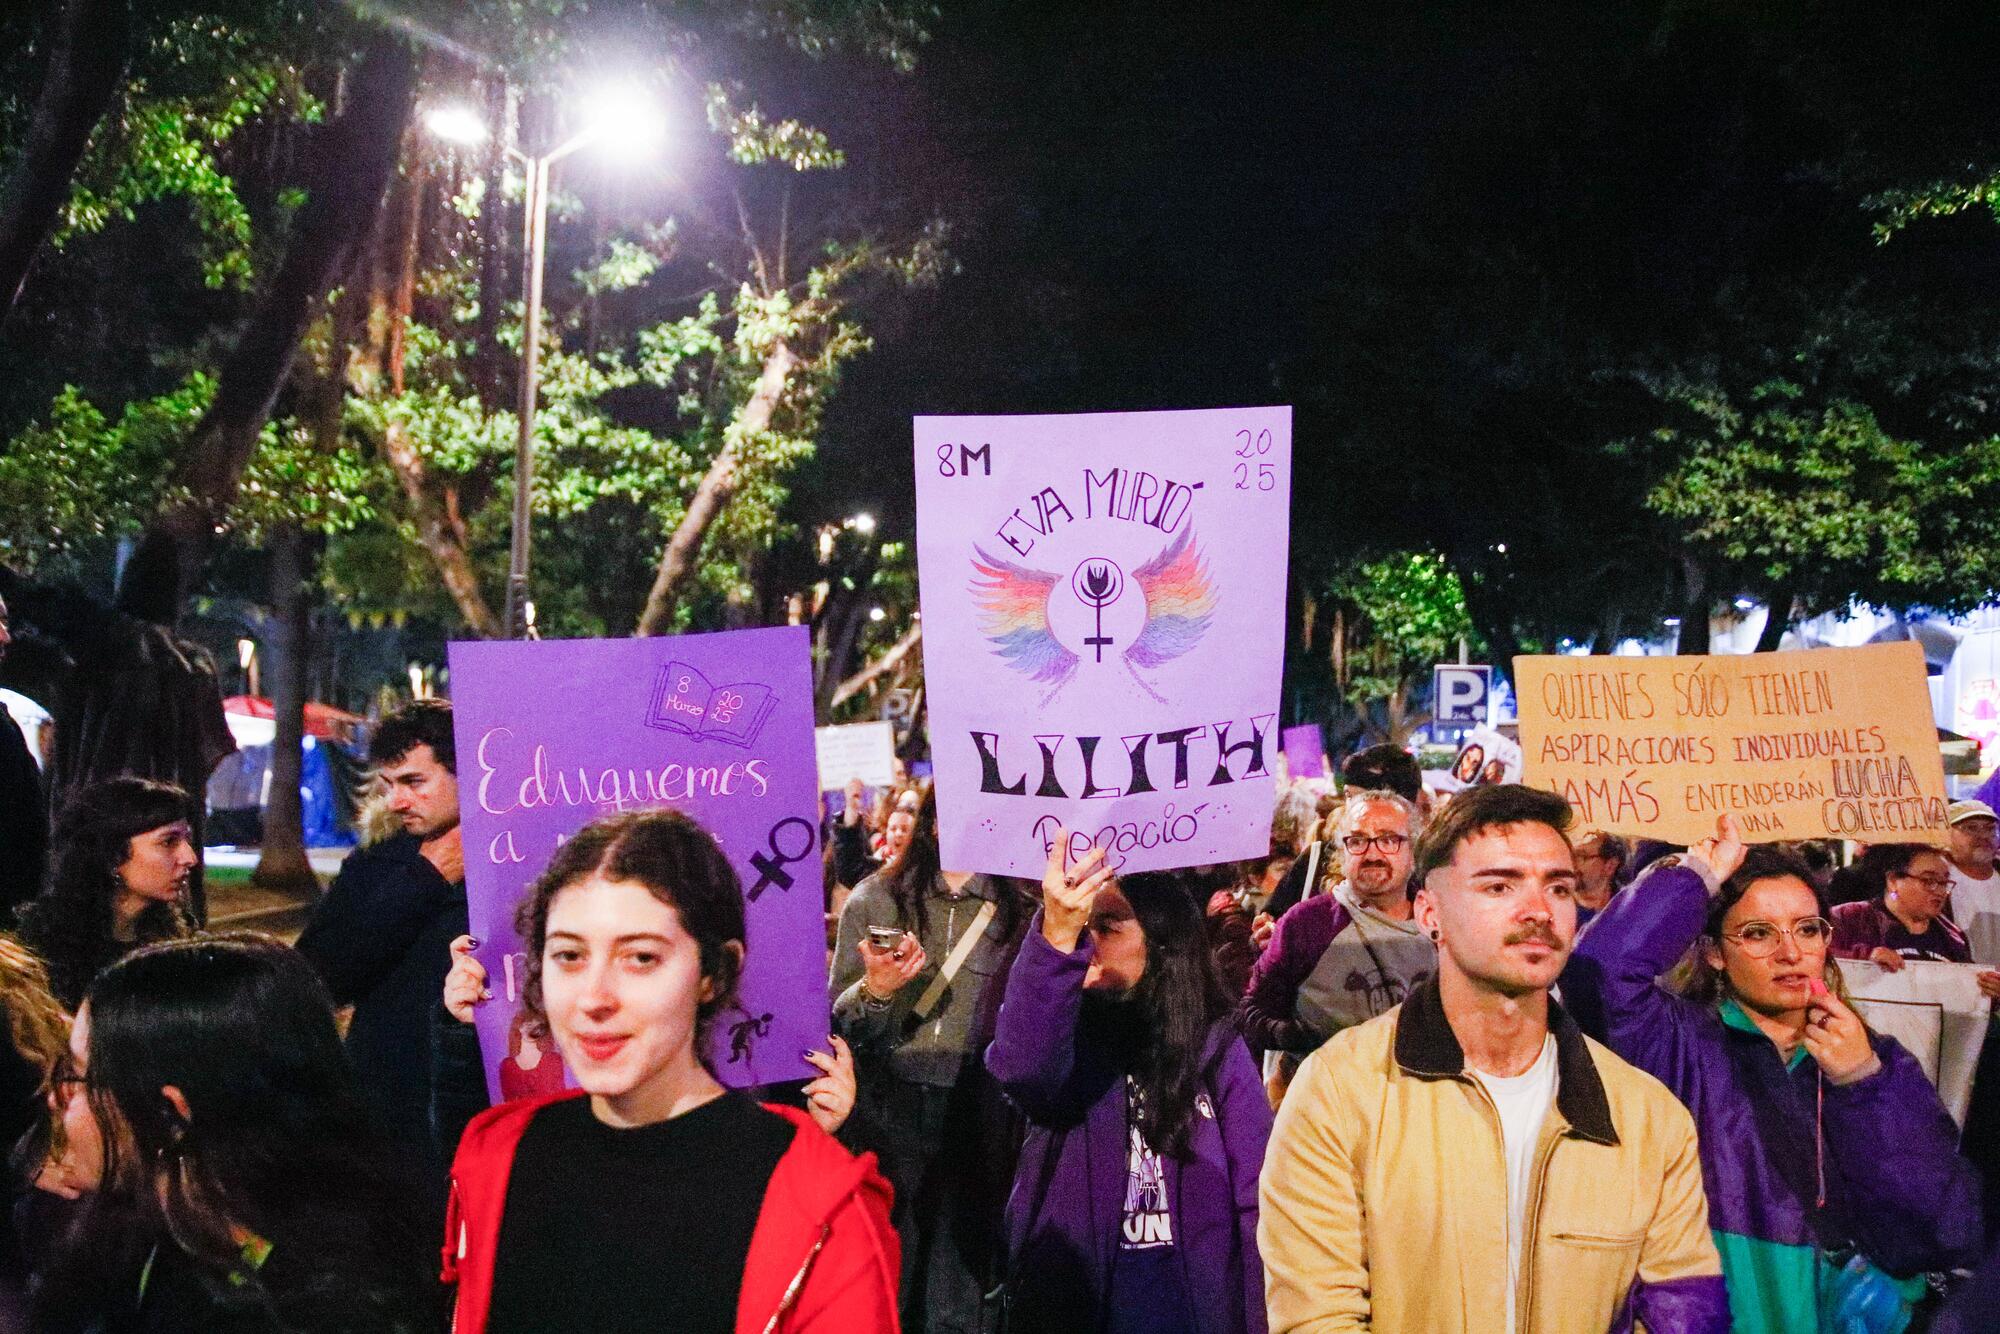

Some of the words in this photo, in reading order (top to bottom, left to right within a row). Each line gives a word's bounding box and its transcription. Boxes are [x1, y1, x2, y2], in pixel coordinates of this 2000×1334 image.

[937, 443, 992, 477] 8M
[1235, 428, 1272, 459] 20
[1233, 463, 1276, 491] 25
[995, 486, 1075, 558] EVA
[1083, 467, 1205, 534] MURIÓ
[677, 675, 691, 693] 8
[717, 690, 744, 710] 20
[1440, 670, 1485, 720] P
[1541, 671, 1655, 721] QUIENES
[1672, 662, 1730, 718] SÓLO
[1740, 669, 1834, 717] TIENEN
[710, 706, 735, 724] 25
[969, 713, 1276, 800] LILITH
[1540, 732, 1716, 767] ASPIRACIONES
[1732, 725, 1887, 763] INDIVIDUALES
[477, 727, 769, 814] Eduquemos
[1832, 755, 1922, 799] LUCHA
[1685, 771, 1826, 813] ENTENDERÁN
[1742, 813, 1784, 833] UNA
[1822, 796, 1950, 835] COLECTIVA
[488, 830, 526, 864] a
